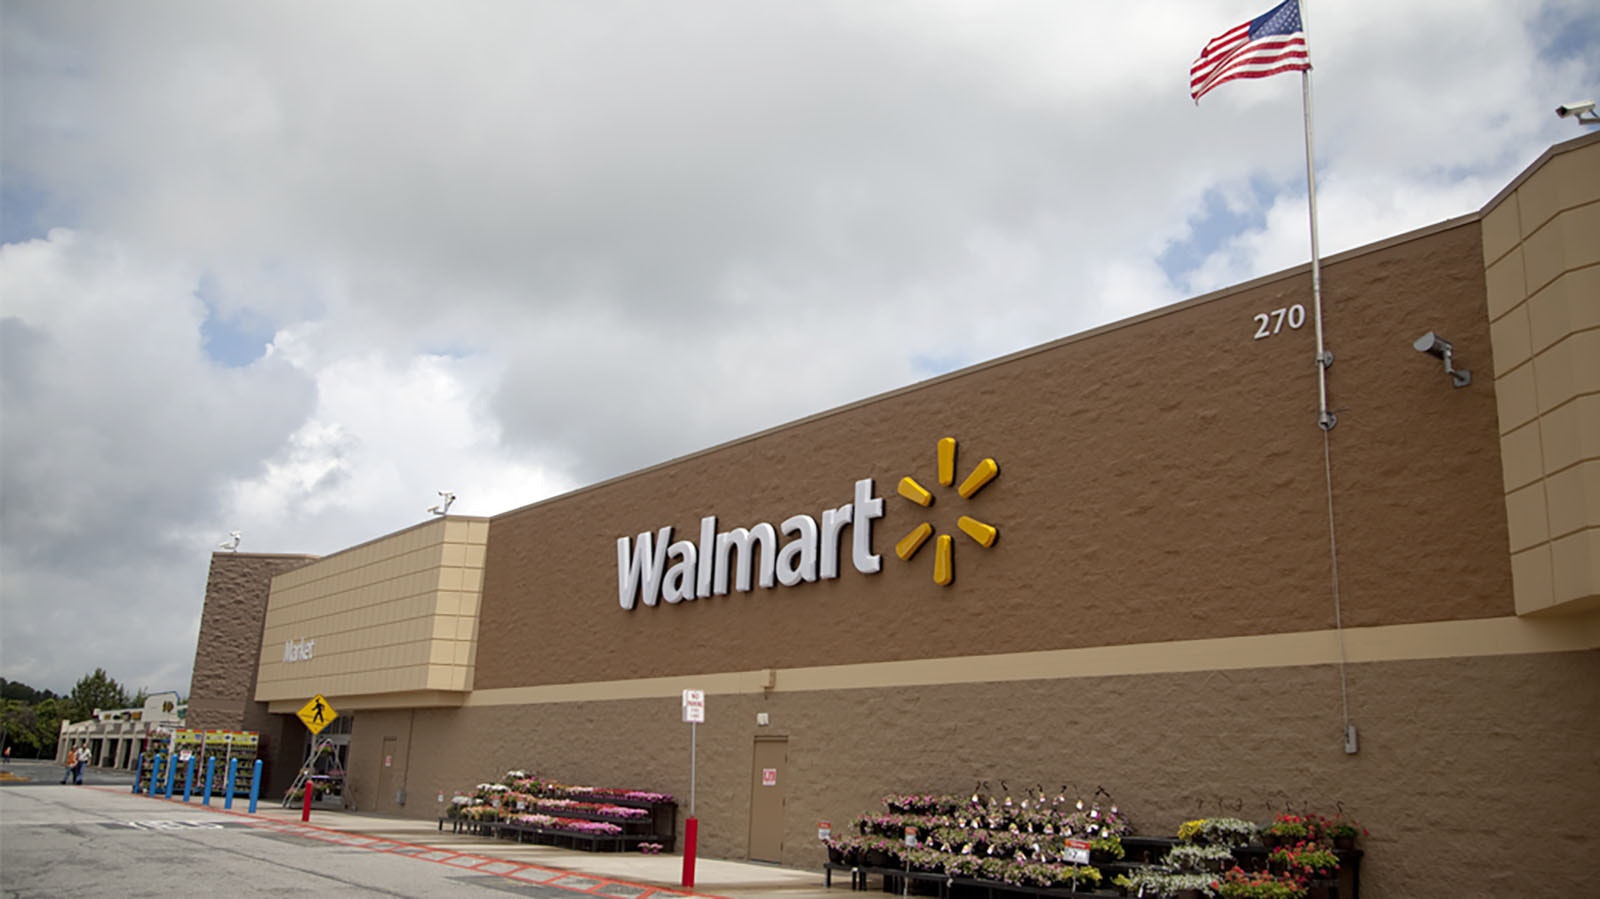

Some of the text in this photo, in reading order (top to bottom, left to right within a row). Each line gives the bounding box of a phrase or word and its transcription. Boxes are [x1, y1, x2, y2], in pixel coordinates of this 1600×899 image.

[1253, 303, 1306, 340] 270
[617, 477, 883, 610] Walmart
[283, 637, 315, 663] Market
